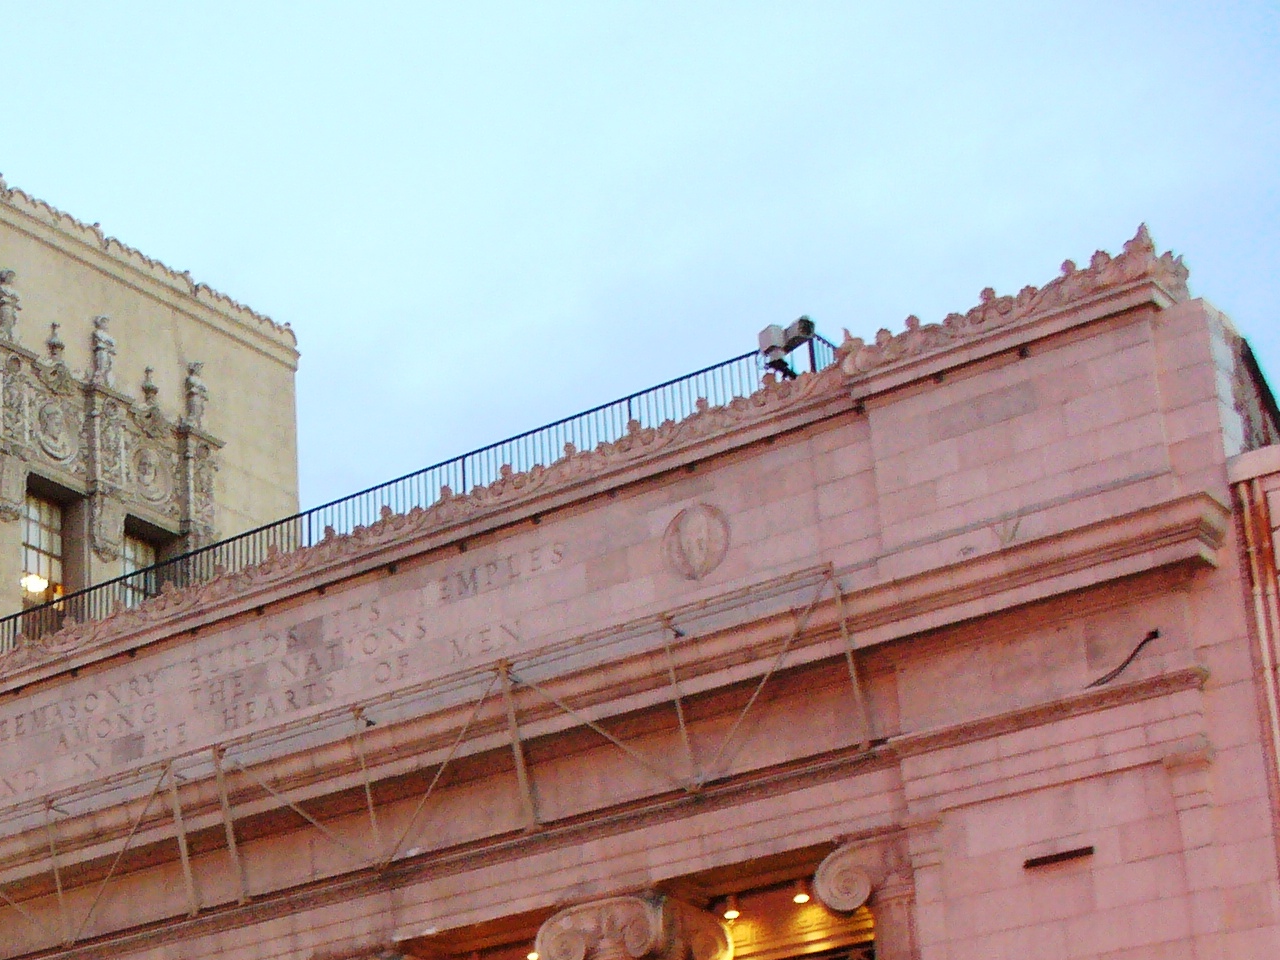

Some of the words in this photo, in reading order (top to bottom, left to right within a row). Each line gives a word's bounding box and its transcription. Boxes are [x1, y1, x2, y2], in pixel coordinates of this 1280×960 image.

[190, 629, 298, 681] BUILDS
[331, 599, 381, 635] ITS
[422, 543, 564, 602] EMPLES
[222, 682, 336, 731] HEARTS
[374, 654, 410, 684] OF
[449, 620, 523, 666] MEN
[57, 702, 158, 750] AMONG
[188, 673, 245, 710] THE
[280, 617, 427, 684] NATIONS
